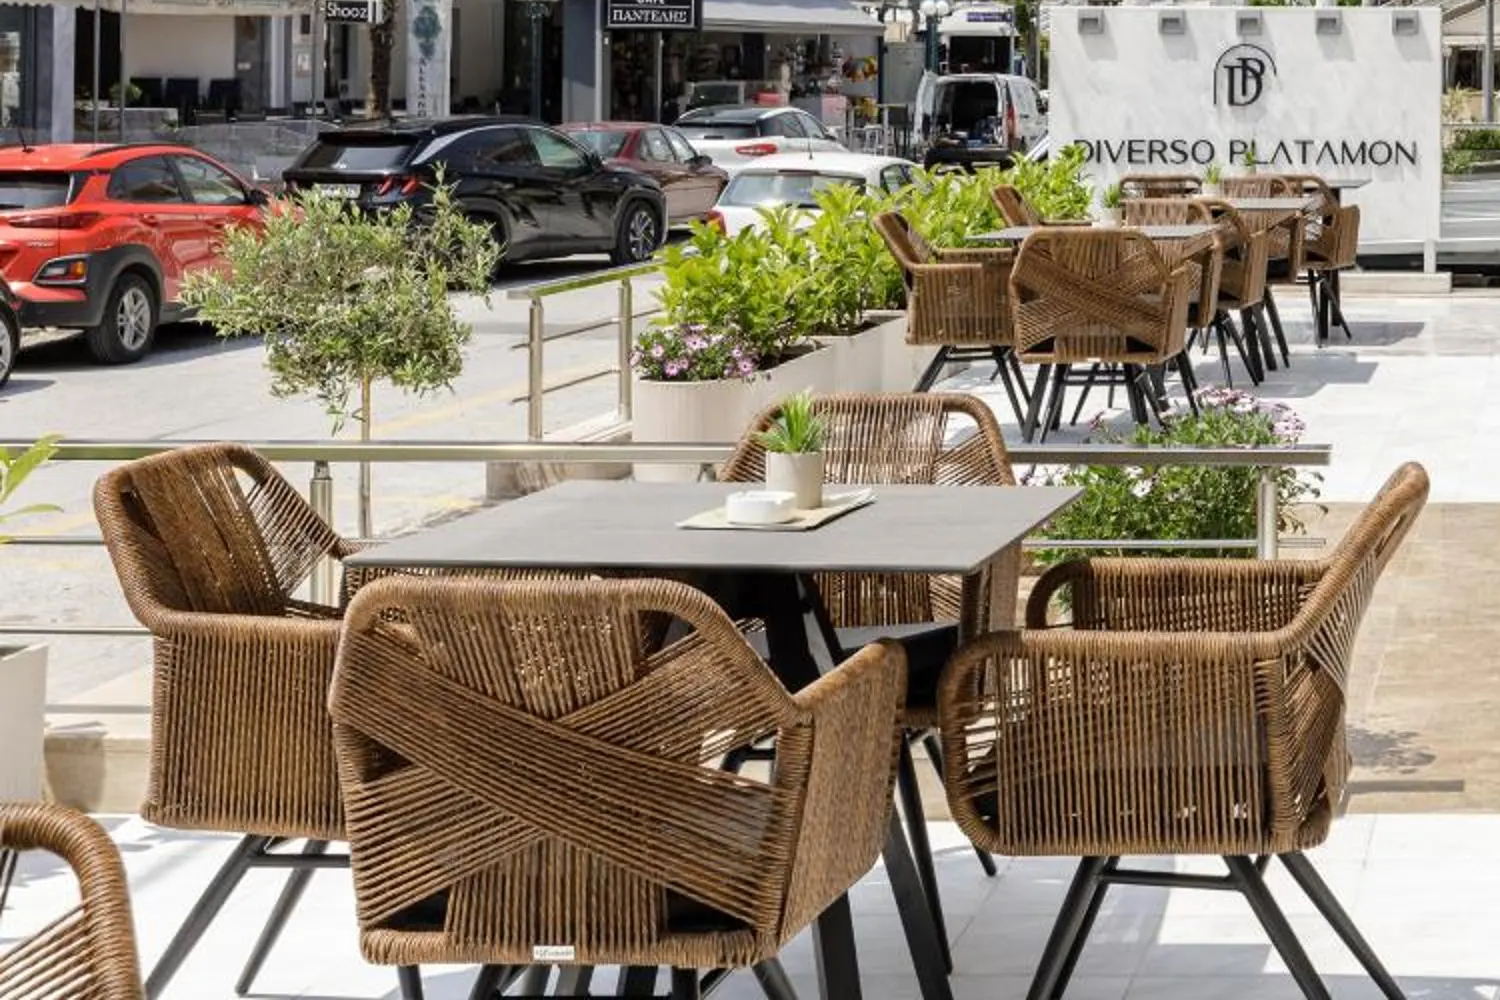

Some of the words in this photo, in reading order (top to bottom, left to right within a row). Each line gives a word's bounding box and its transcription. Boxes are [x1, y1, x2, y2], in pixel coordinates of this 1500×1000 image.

[613, 9, 687, 22] ΠΑΝΤΕΛΗΣ
[1073, 139, 1215, 164] DIVERSO
[1229, 139, 1417, 166] PLATAMON
